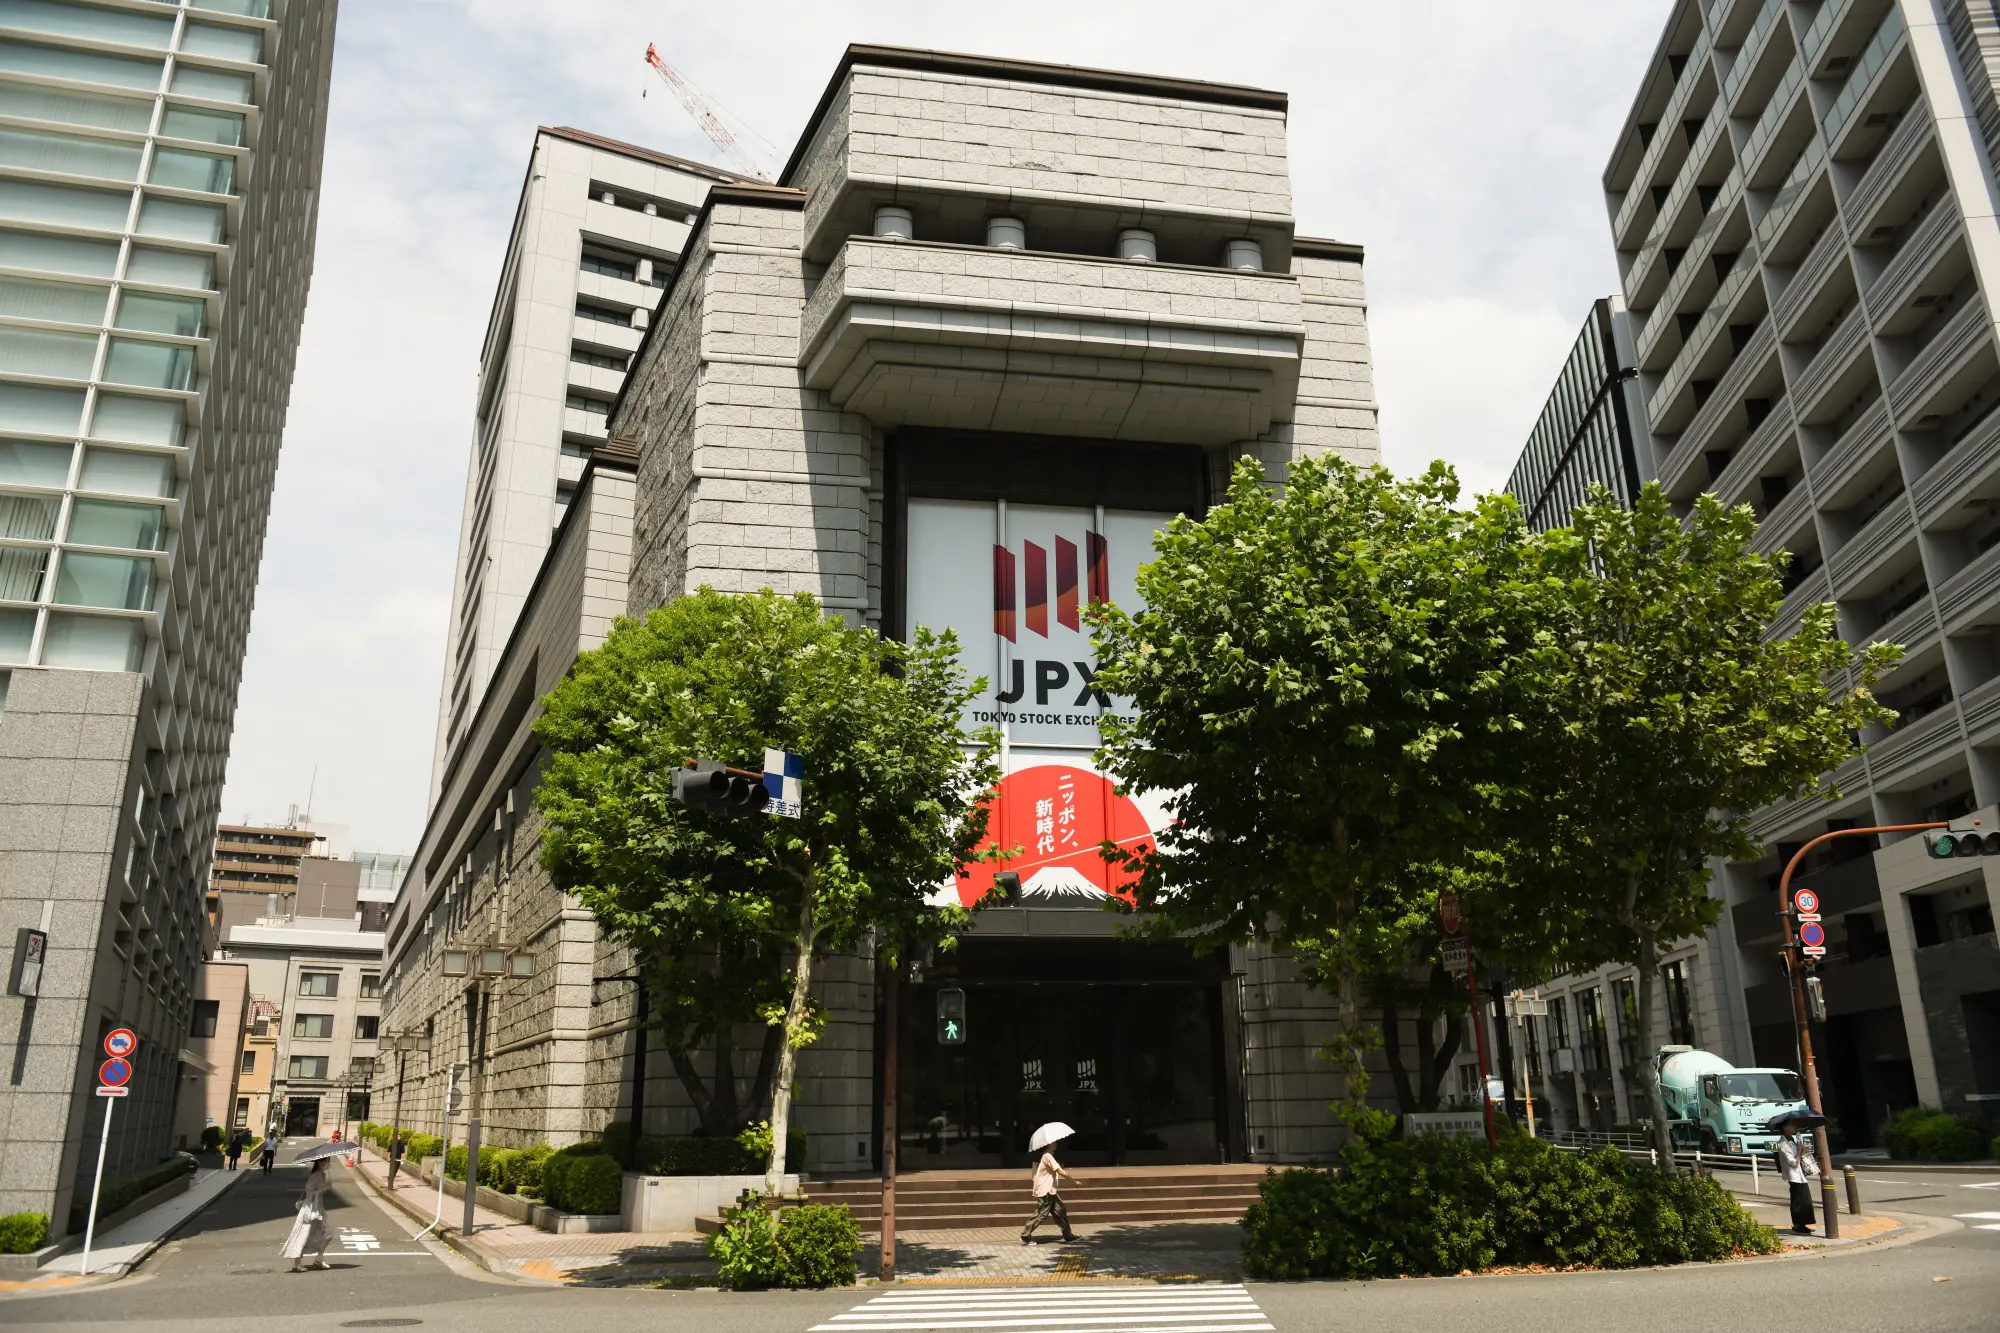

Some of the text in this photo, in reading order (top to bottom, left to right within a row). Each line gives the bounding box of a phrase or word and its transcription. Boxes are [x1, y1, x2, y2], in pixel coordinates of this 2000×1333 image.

[995, 659, 1113, 708] JPX
[973, 711, 1136, 727] TOKYO STOCK EXCHGE
[1035, 797, 1055, 856] 新時代
[1800, 896, 1814, 906] 30
[1023, 1080, 1042, 1089] JPX
[1078, 1080, 1096, 1089] JPX
[1737, 1108, 1753, 1117] 713
